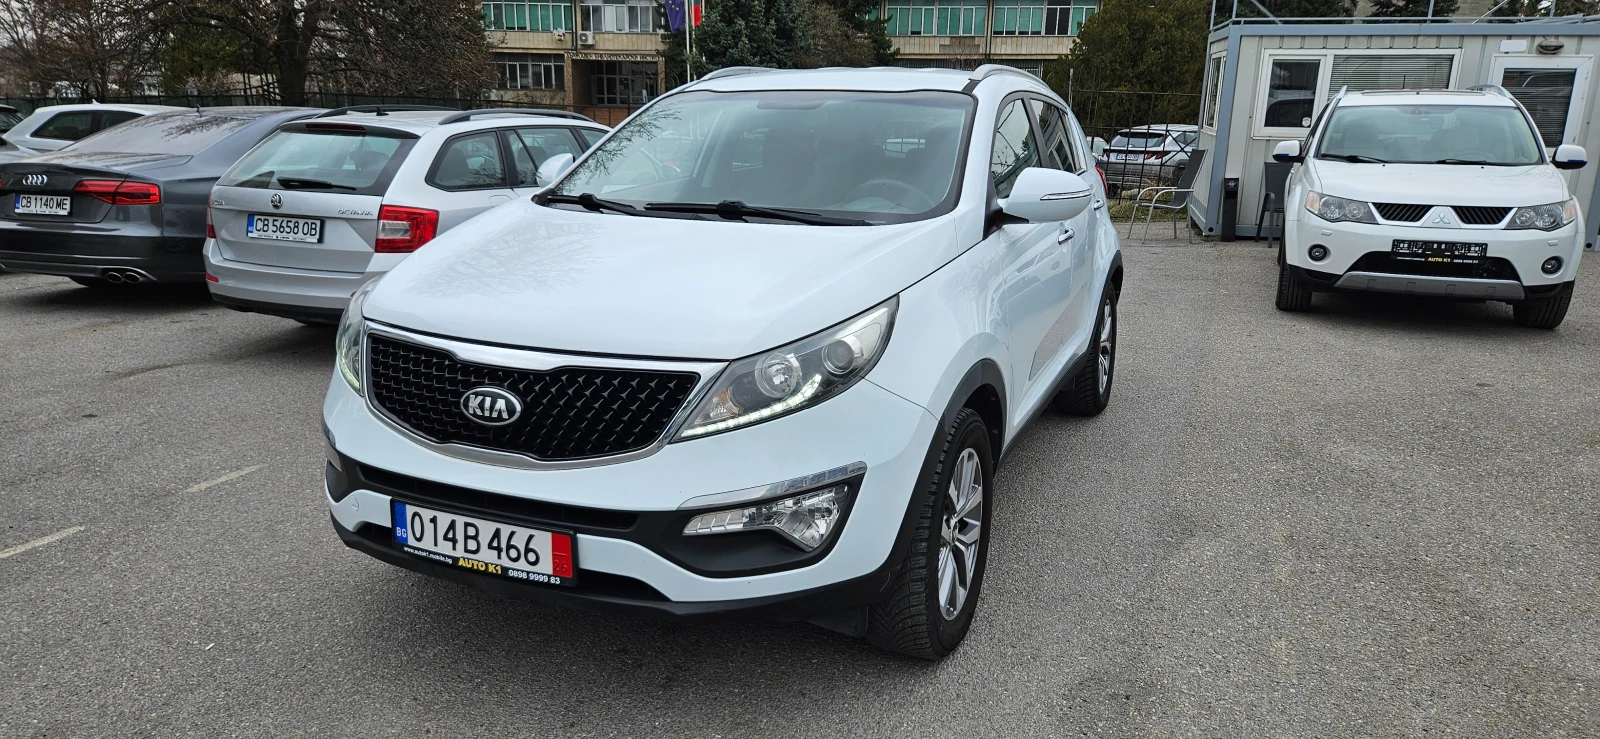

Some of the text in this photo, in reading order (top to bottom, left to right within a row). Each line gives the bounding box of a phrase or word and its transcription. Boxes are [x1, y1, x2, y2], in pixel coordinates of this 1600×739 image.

[21, 196, 32, 208] CB
[34, 197, 54, 209] 1140
[56, 198, 68, 210] ME
[255, 218, 270, 232] CB
[271, 219, 300, 235] 5658
[302, 221, 318, 237] OB
[469, 395, 509, 418] KIA
[396, 526, 407, 538] BG
[403, 546, 561, 585] www.autok1.mobile.bg AUTO K1 0898 9999 83
